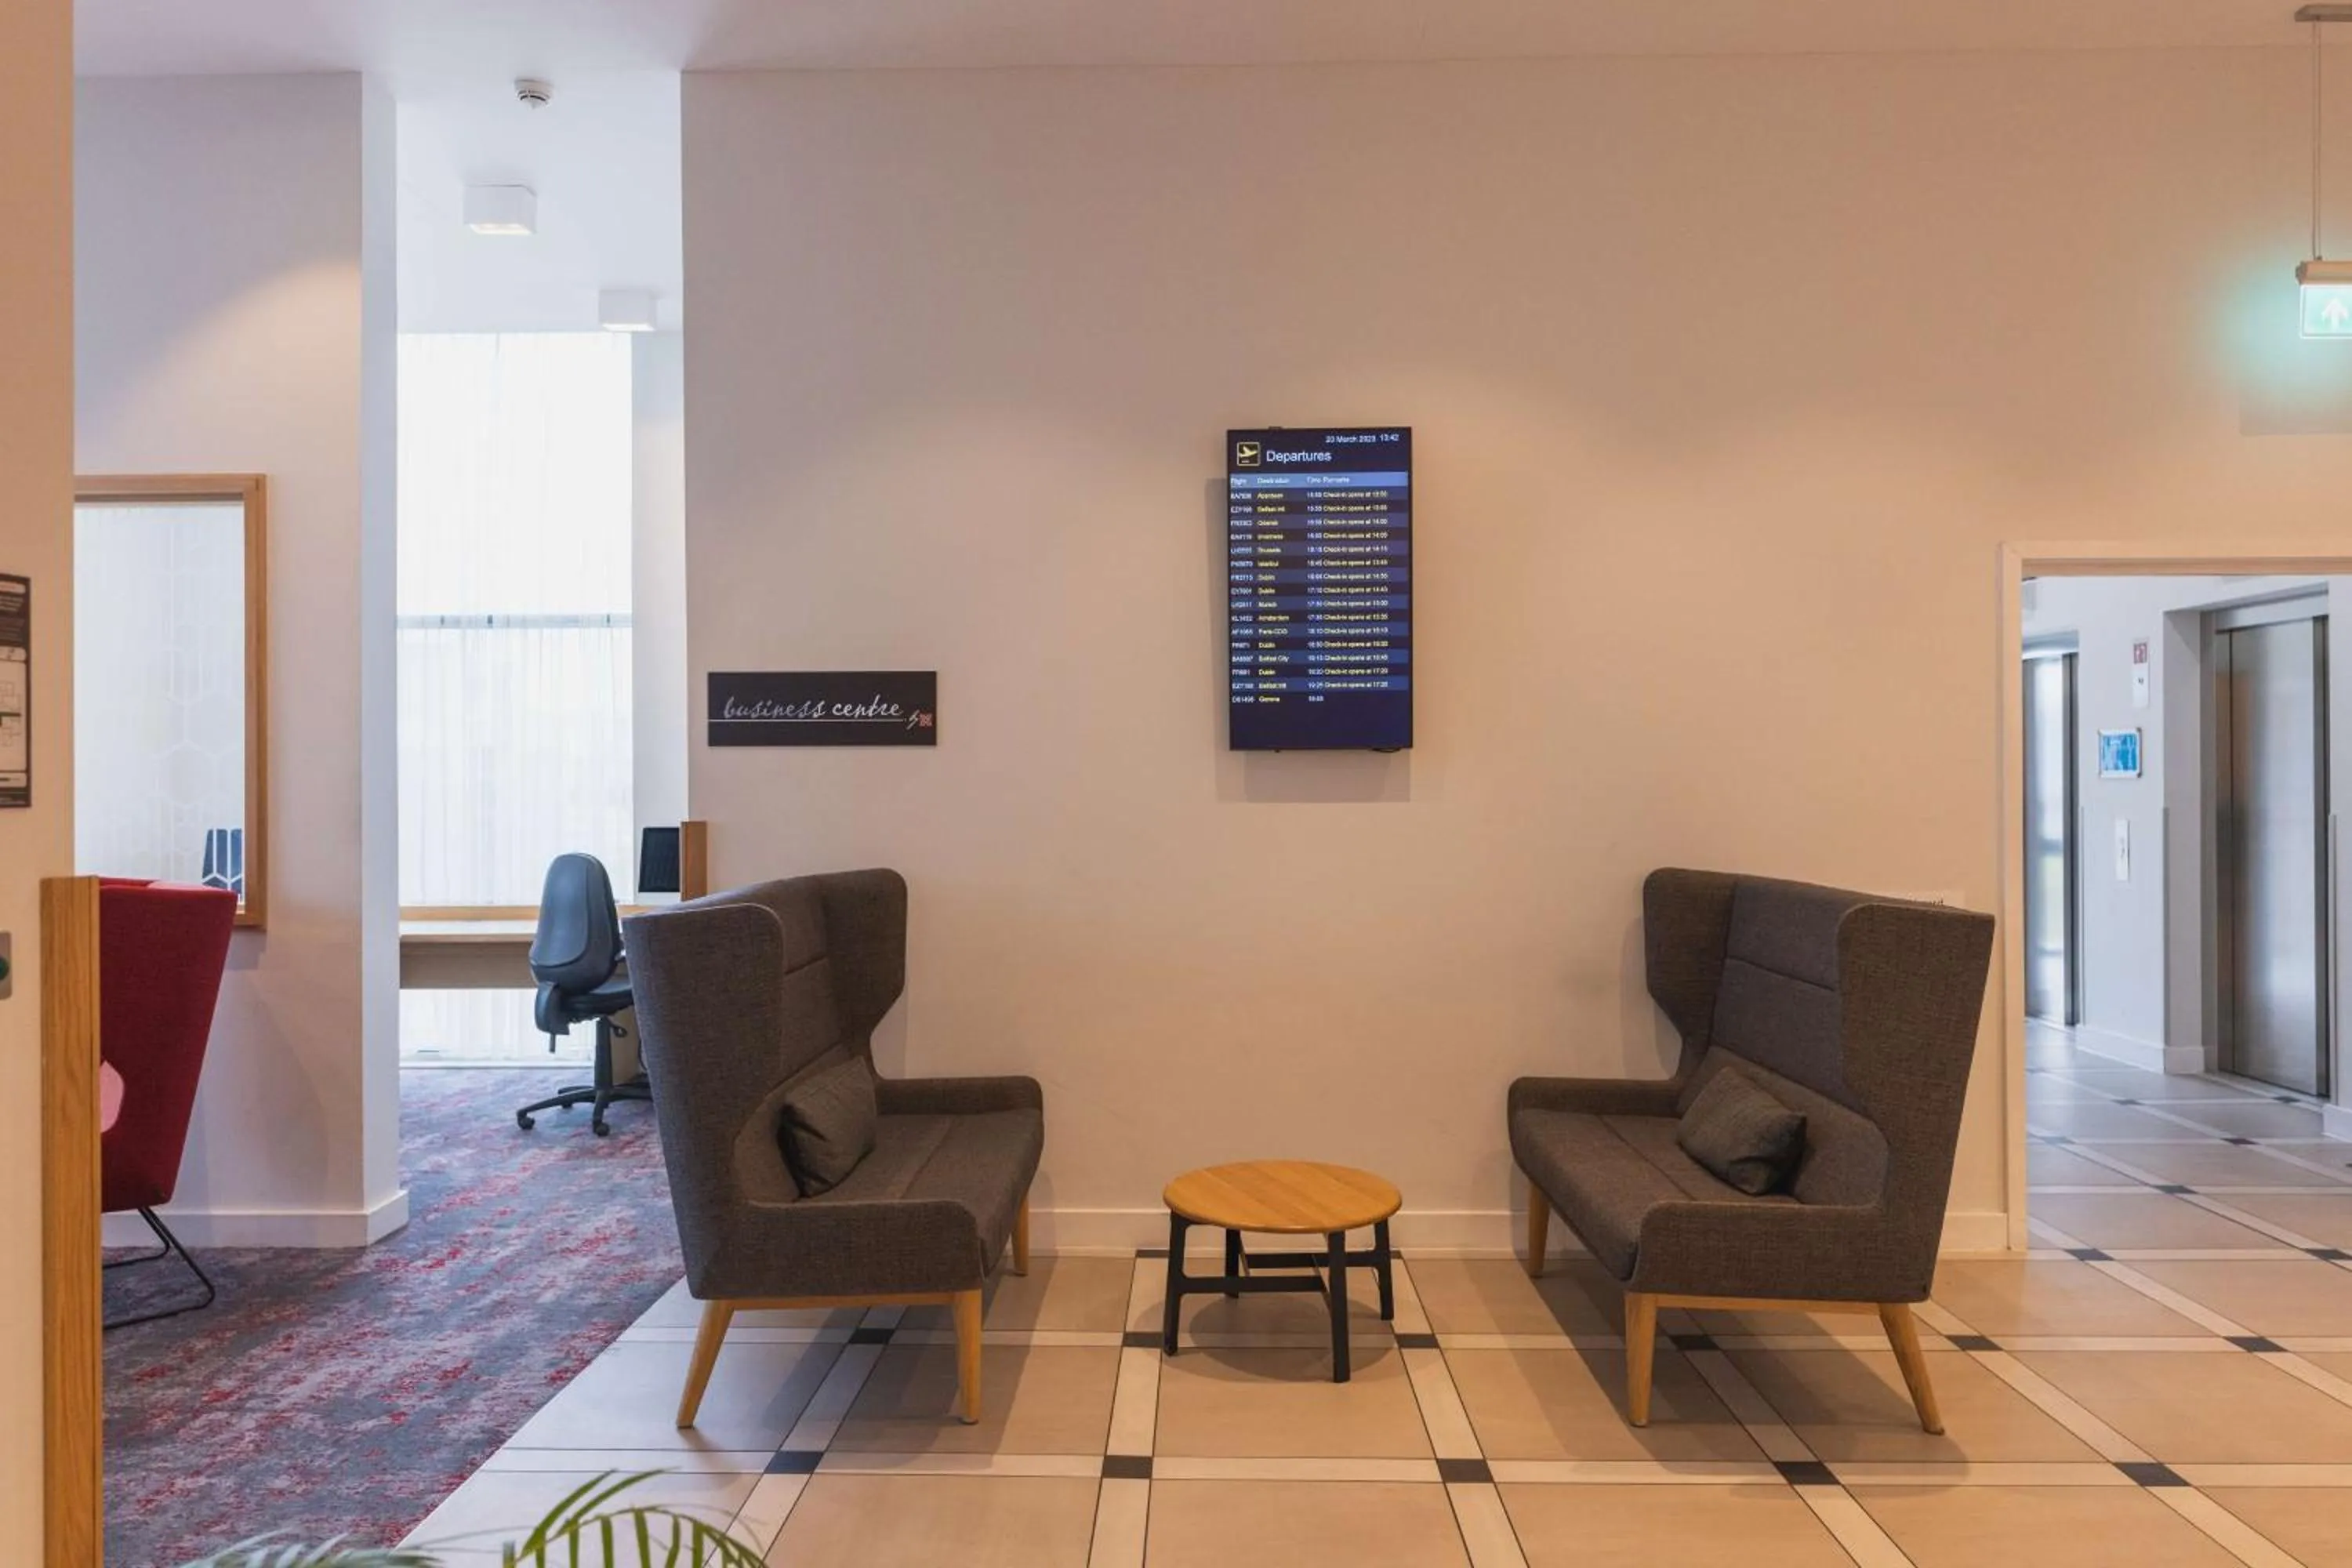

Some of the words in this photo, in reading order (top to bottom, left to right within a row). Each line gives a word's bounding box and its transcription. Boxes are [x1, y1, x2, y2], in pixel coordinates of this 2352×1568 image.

[1266, 450, 1333, 464] Departures
[723, 696, 827, 719] business
[831, 693, 904, 719] centre
